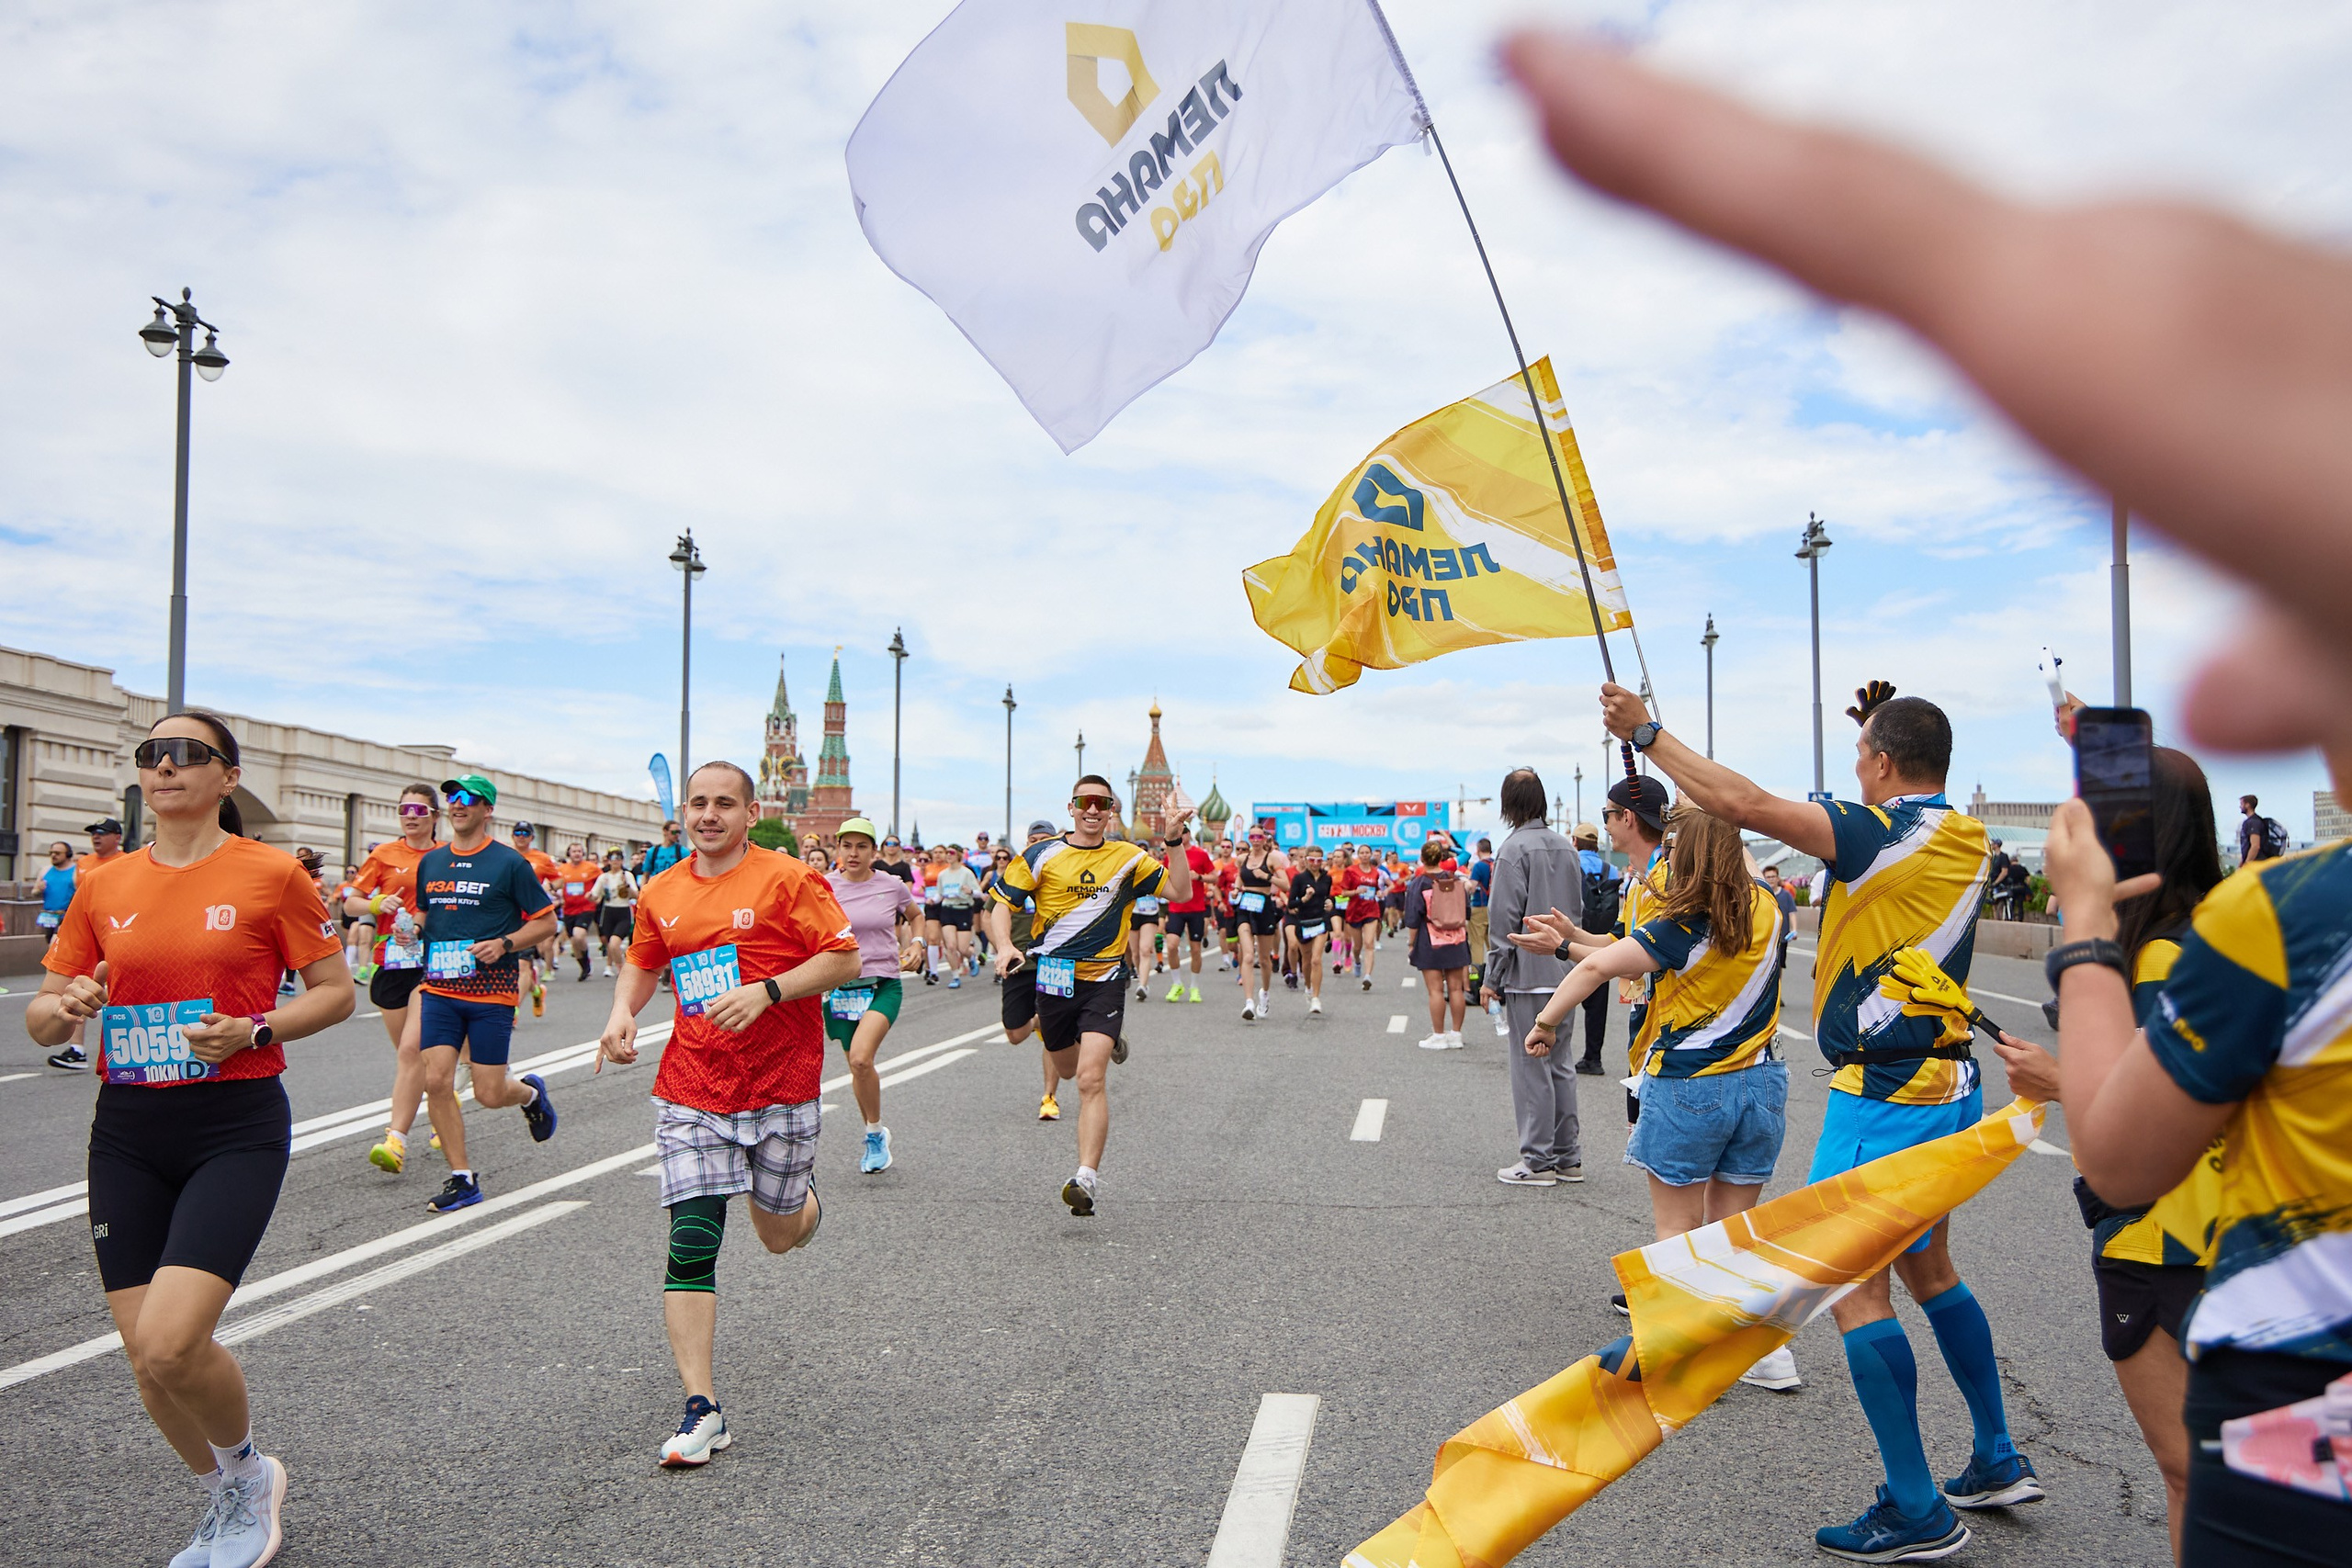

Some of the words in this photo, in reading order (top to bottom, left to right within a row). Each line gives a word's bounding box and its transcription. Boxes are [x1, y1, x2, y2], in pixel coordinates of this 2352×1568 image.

[1351, 824, 1386, 837] МОСКВУ
[425, 880, 491, 896] #ЗАБЕГ
[205, 904, 237, 931] 10
[731, 908, 754, 930] 10
[461, 965, 470, 974] D
[1039, 964, 1070, 987] 62126
[680, 962, 736, 1001] 58931
[1066, 987, 1073, 996] D
[112, 1013, 126, 1021] ПСБ
[110, 1022, 208, 1065] 5059
[187, 1061, 205, 1078] D
